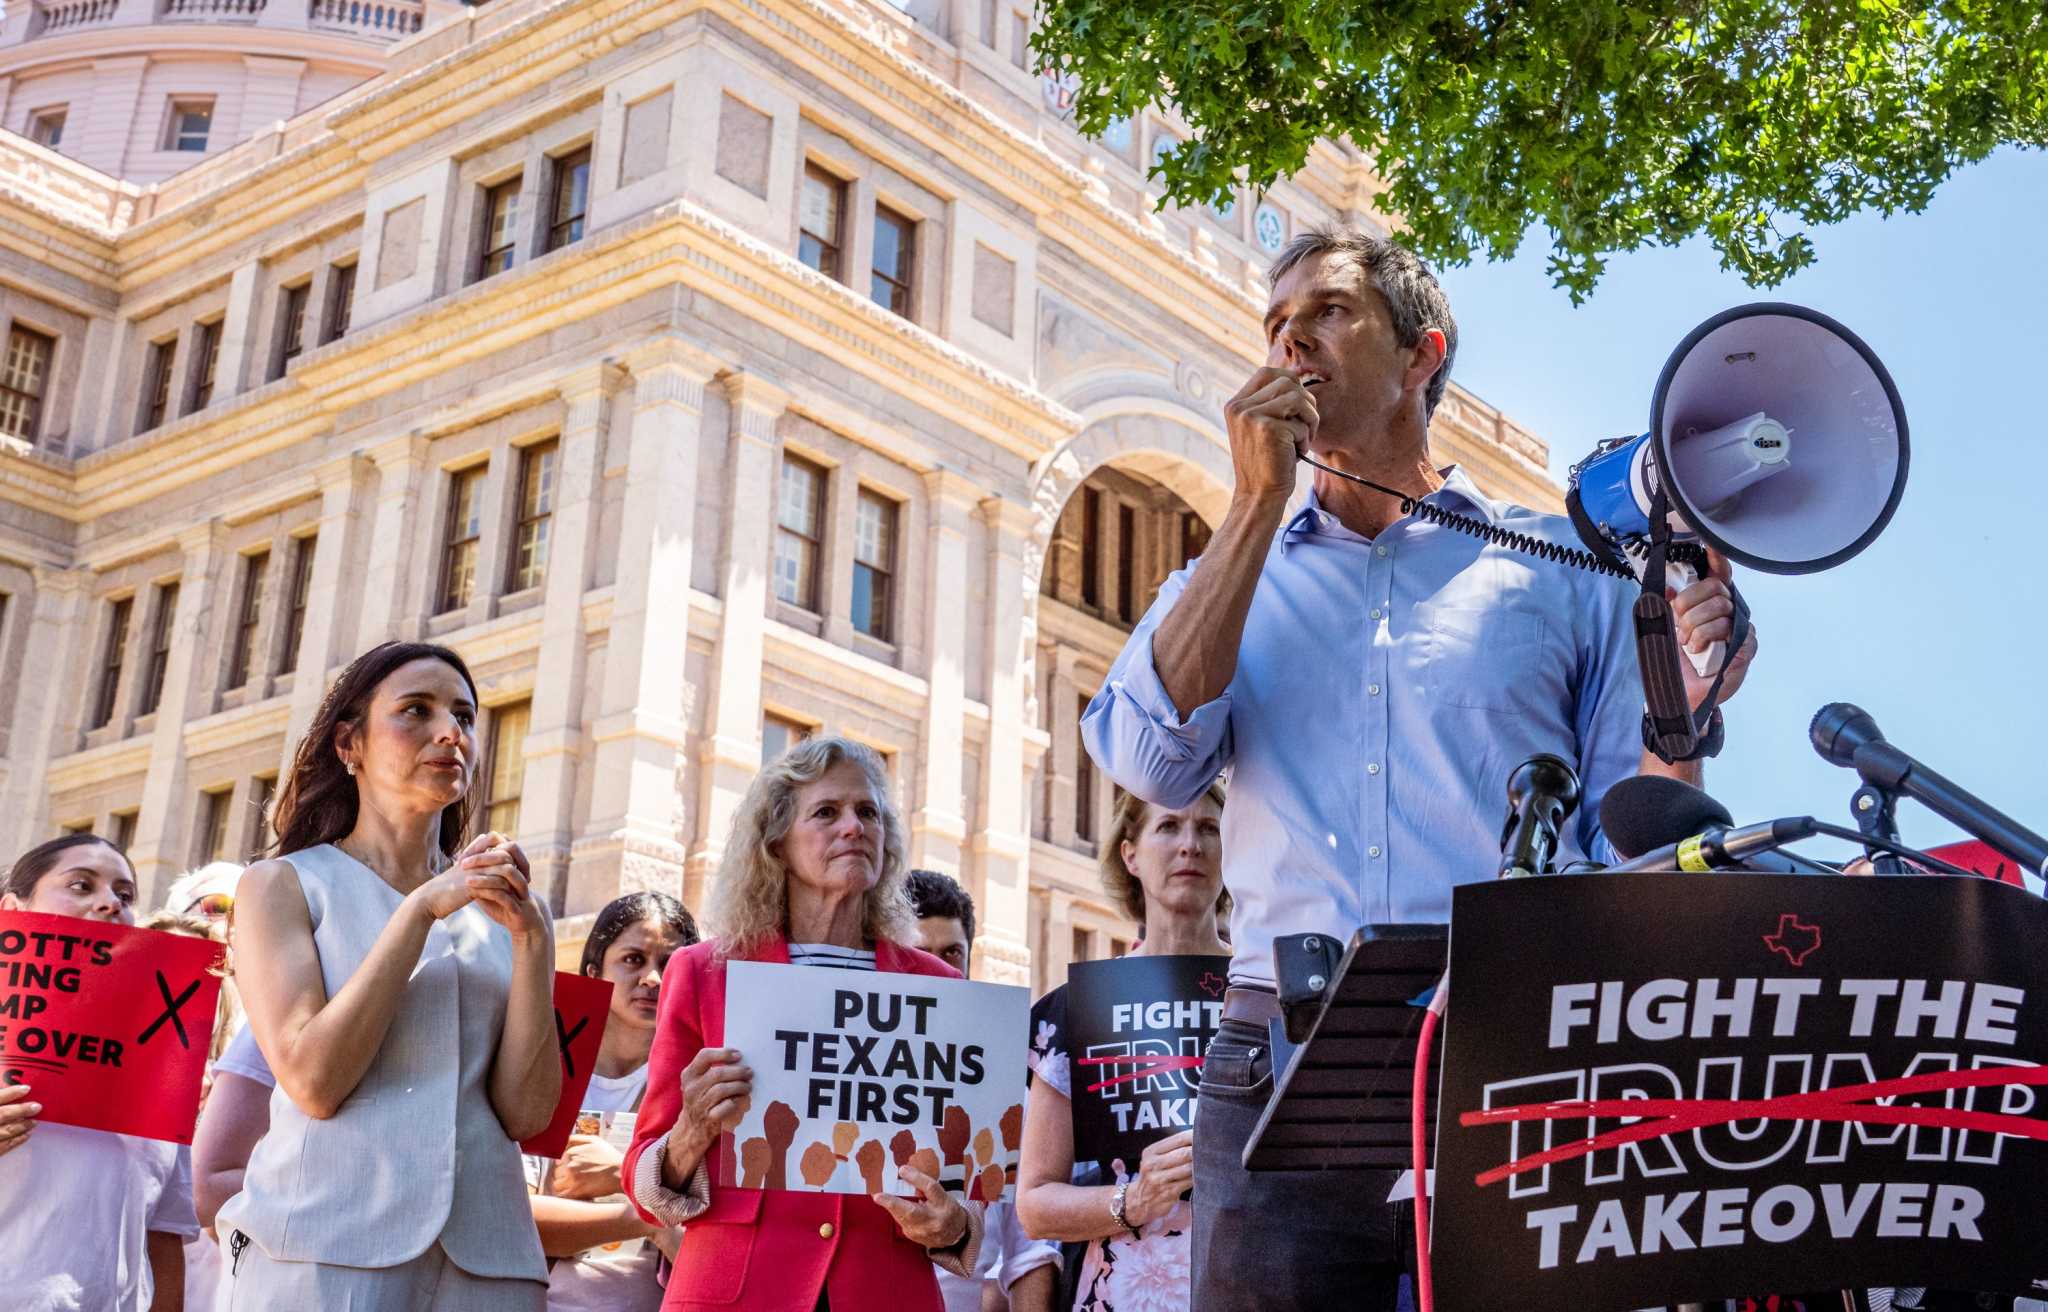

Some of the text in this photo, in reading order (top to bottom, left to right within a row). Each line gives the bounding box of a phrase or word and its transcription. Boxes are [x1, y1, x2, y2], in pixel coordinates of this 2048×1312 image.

[833, 989, 937, 1035] PUT
[1112, 1002, 1223, 1032] FIGHT
[1549, 978, 2025, 1048] FIGHT THE
[18, 1027, 124, 1068] OVER
[775, 1030, 985, 1085] TEXANS
[807, 1078, 954, 1126] FIRST
[1483, 1053, 2048, 1199] TRUMP
[1526, 1183, 1985, 1270] TAKEOVER
